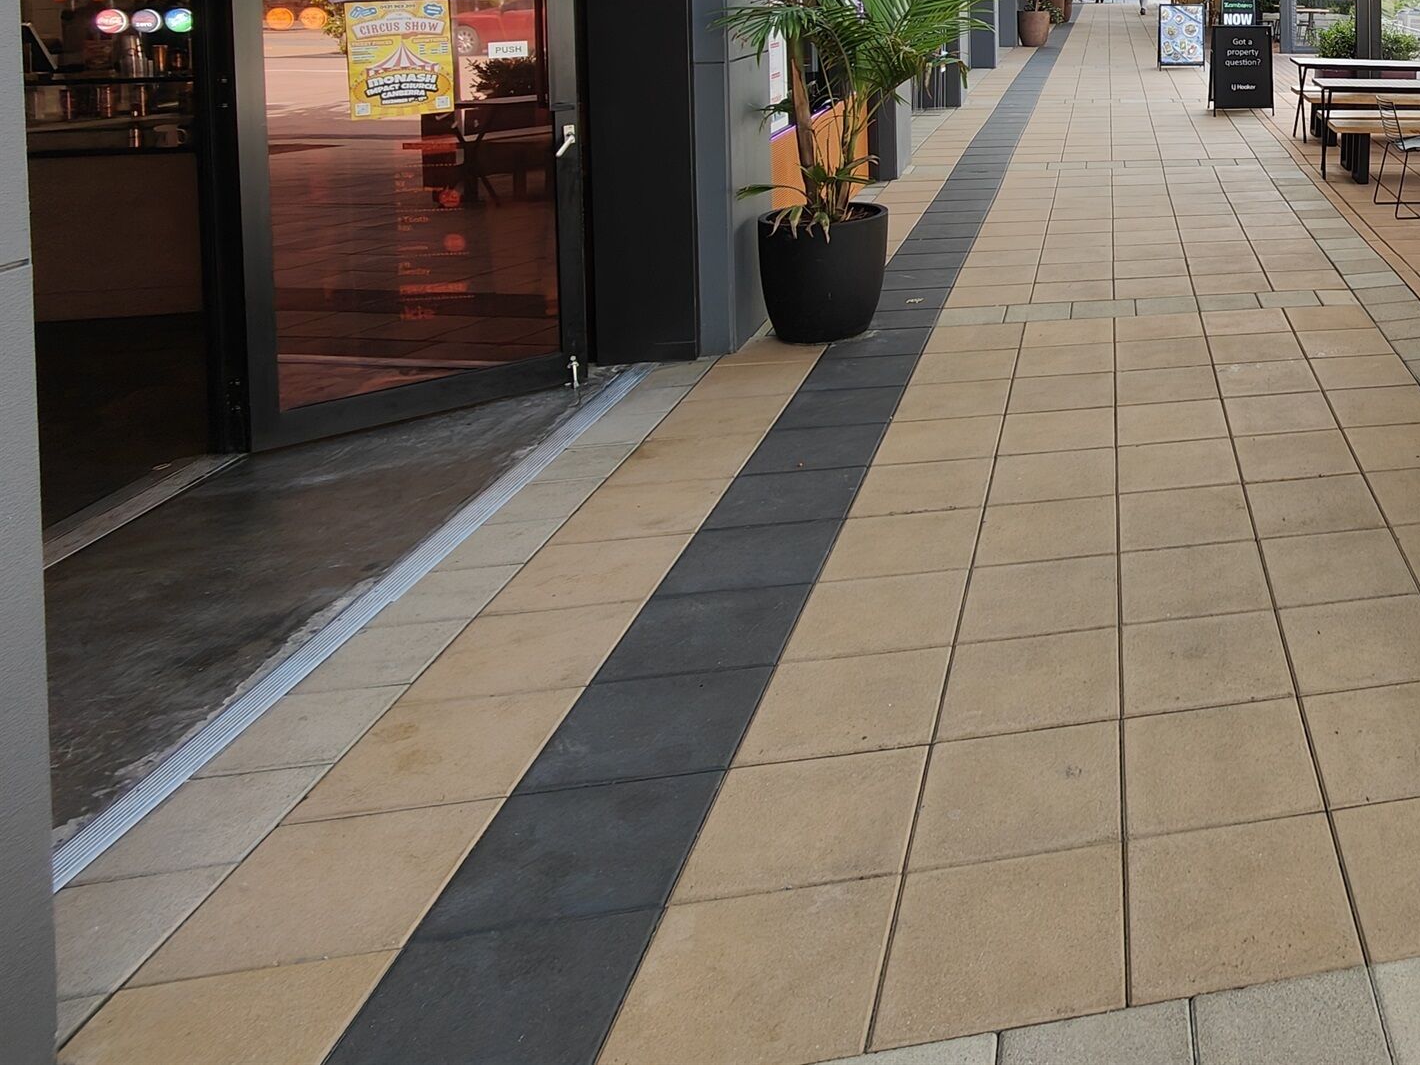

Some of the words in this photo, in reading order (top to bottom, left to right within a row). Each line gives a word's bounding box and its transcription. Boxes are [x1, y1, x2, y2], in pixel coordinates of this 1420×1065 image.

[1223, 13, 1253, 25] NOW
[359, 22, 400, 35] CIRCUS
[404, 21, 439, 31] SHOW
[495, 45, 522, 54] PUSH
[1226, 49, 1259, 57] property
[1224, 58, 1261, 67] question?
[366, 83, 400, 96] IMPACT
[381, 89, 426, 99] CANBERRA
